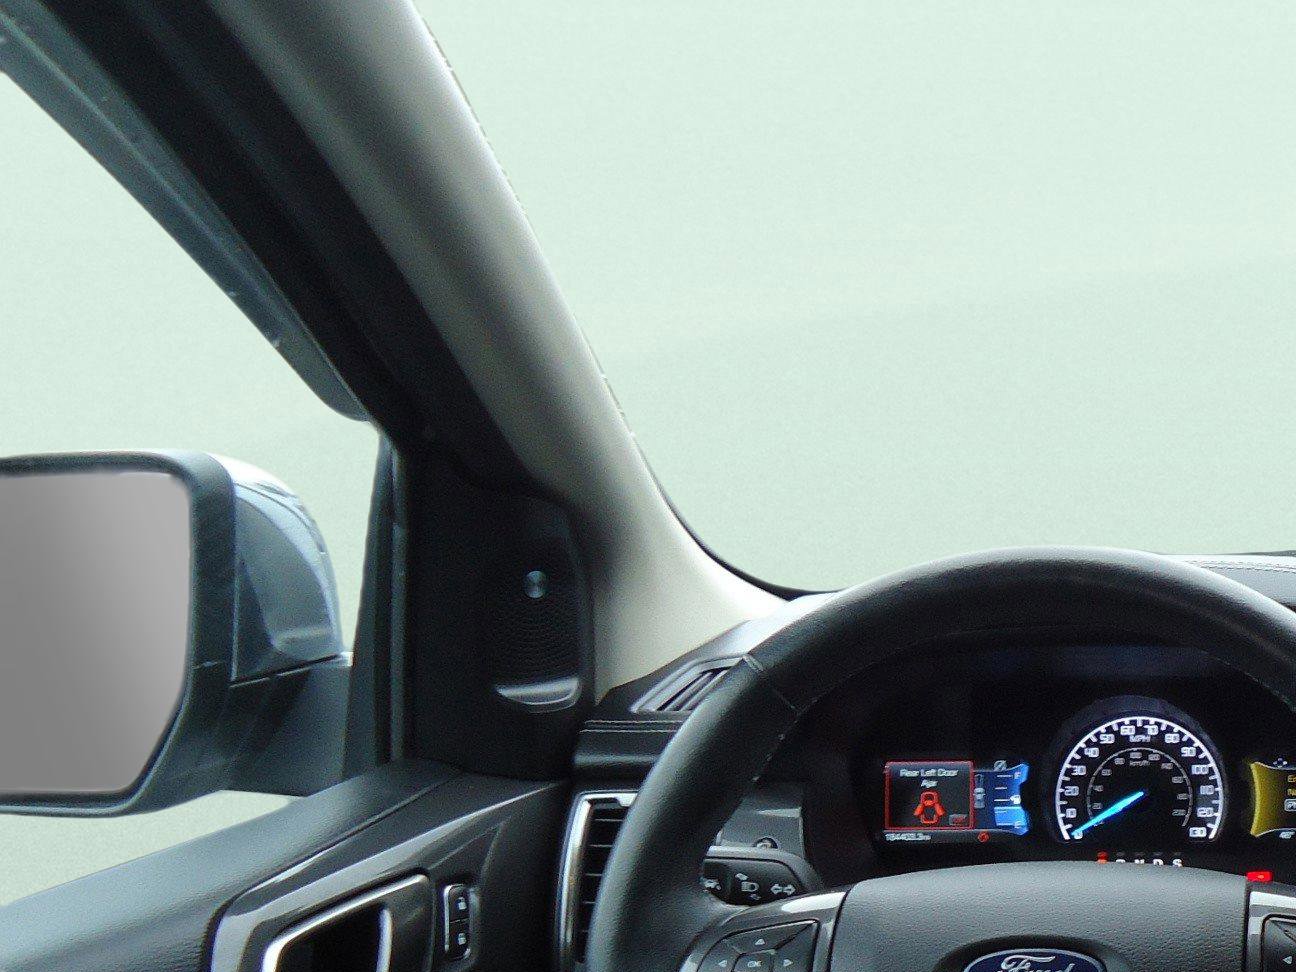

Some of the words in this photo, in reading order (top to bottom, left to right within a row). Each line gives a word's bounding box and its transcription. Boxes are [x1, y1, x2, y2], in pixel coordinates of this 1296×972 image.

[1129, 735, 1151, 744] MPH
[899, 769, 919, 777] Rear
[920, 769, 936, 777] Left
[937, 769, 959, 777] Door
